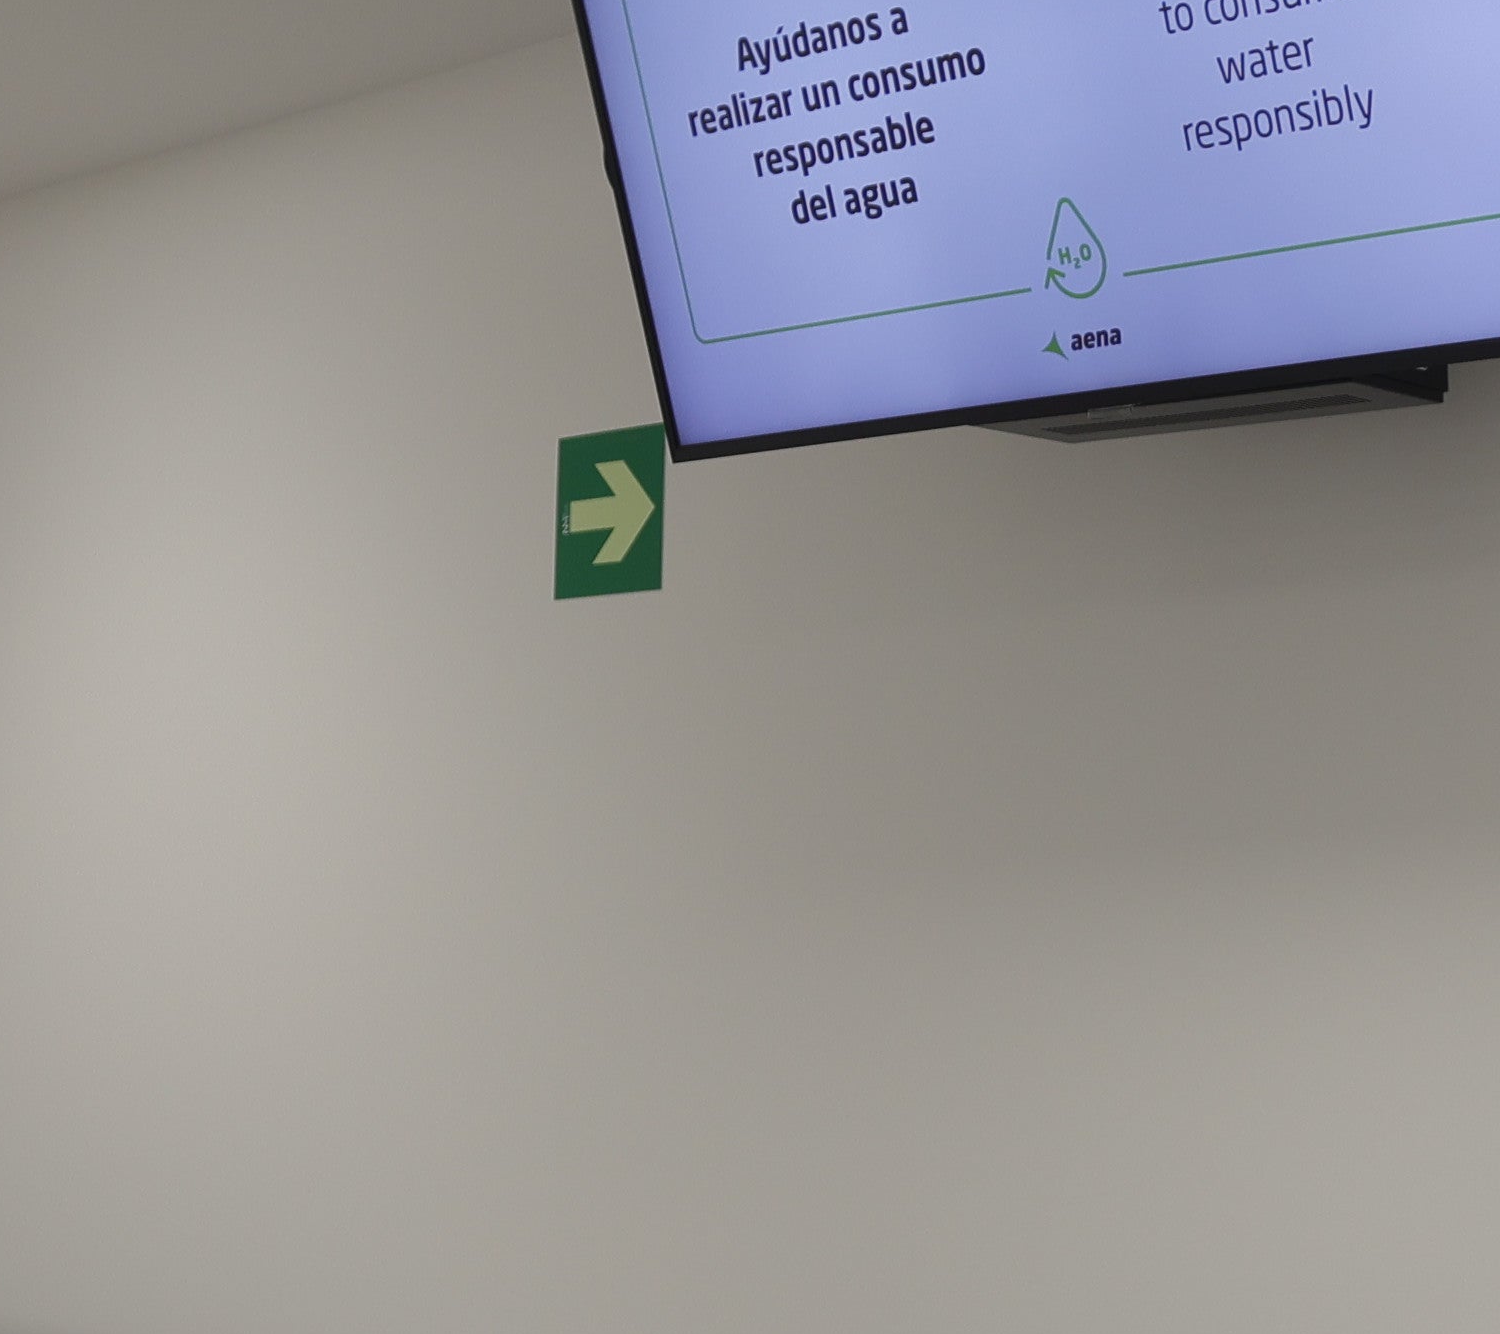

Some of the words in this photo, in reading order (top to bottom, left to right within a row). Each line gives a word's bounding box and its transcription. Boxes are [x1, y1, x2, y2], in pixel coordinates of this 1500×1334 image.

[737, 12, 883, 76] Ayúdanos
[889, 6, 909, 36] a
[1158, 1, 1194, 35] to
[1216, 37, 1314, 84] water
[687, 89, 792, 137] realizar
[801, 79, 841, 112] un
[848, 47, 986, 102] consumo
[1182, 84, 1373, 152] responsibly
[753, 111, 936, 178] responsable
[791, 184, 837, 225] del
[843, 176, 919, 220] agua
[1070, 327, 1122, 351] aena
